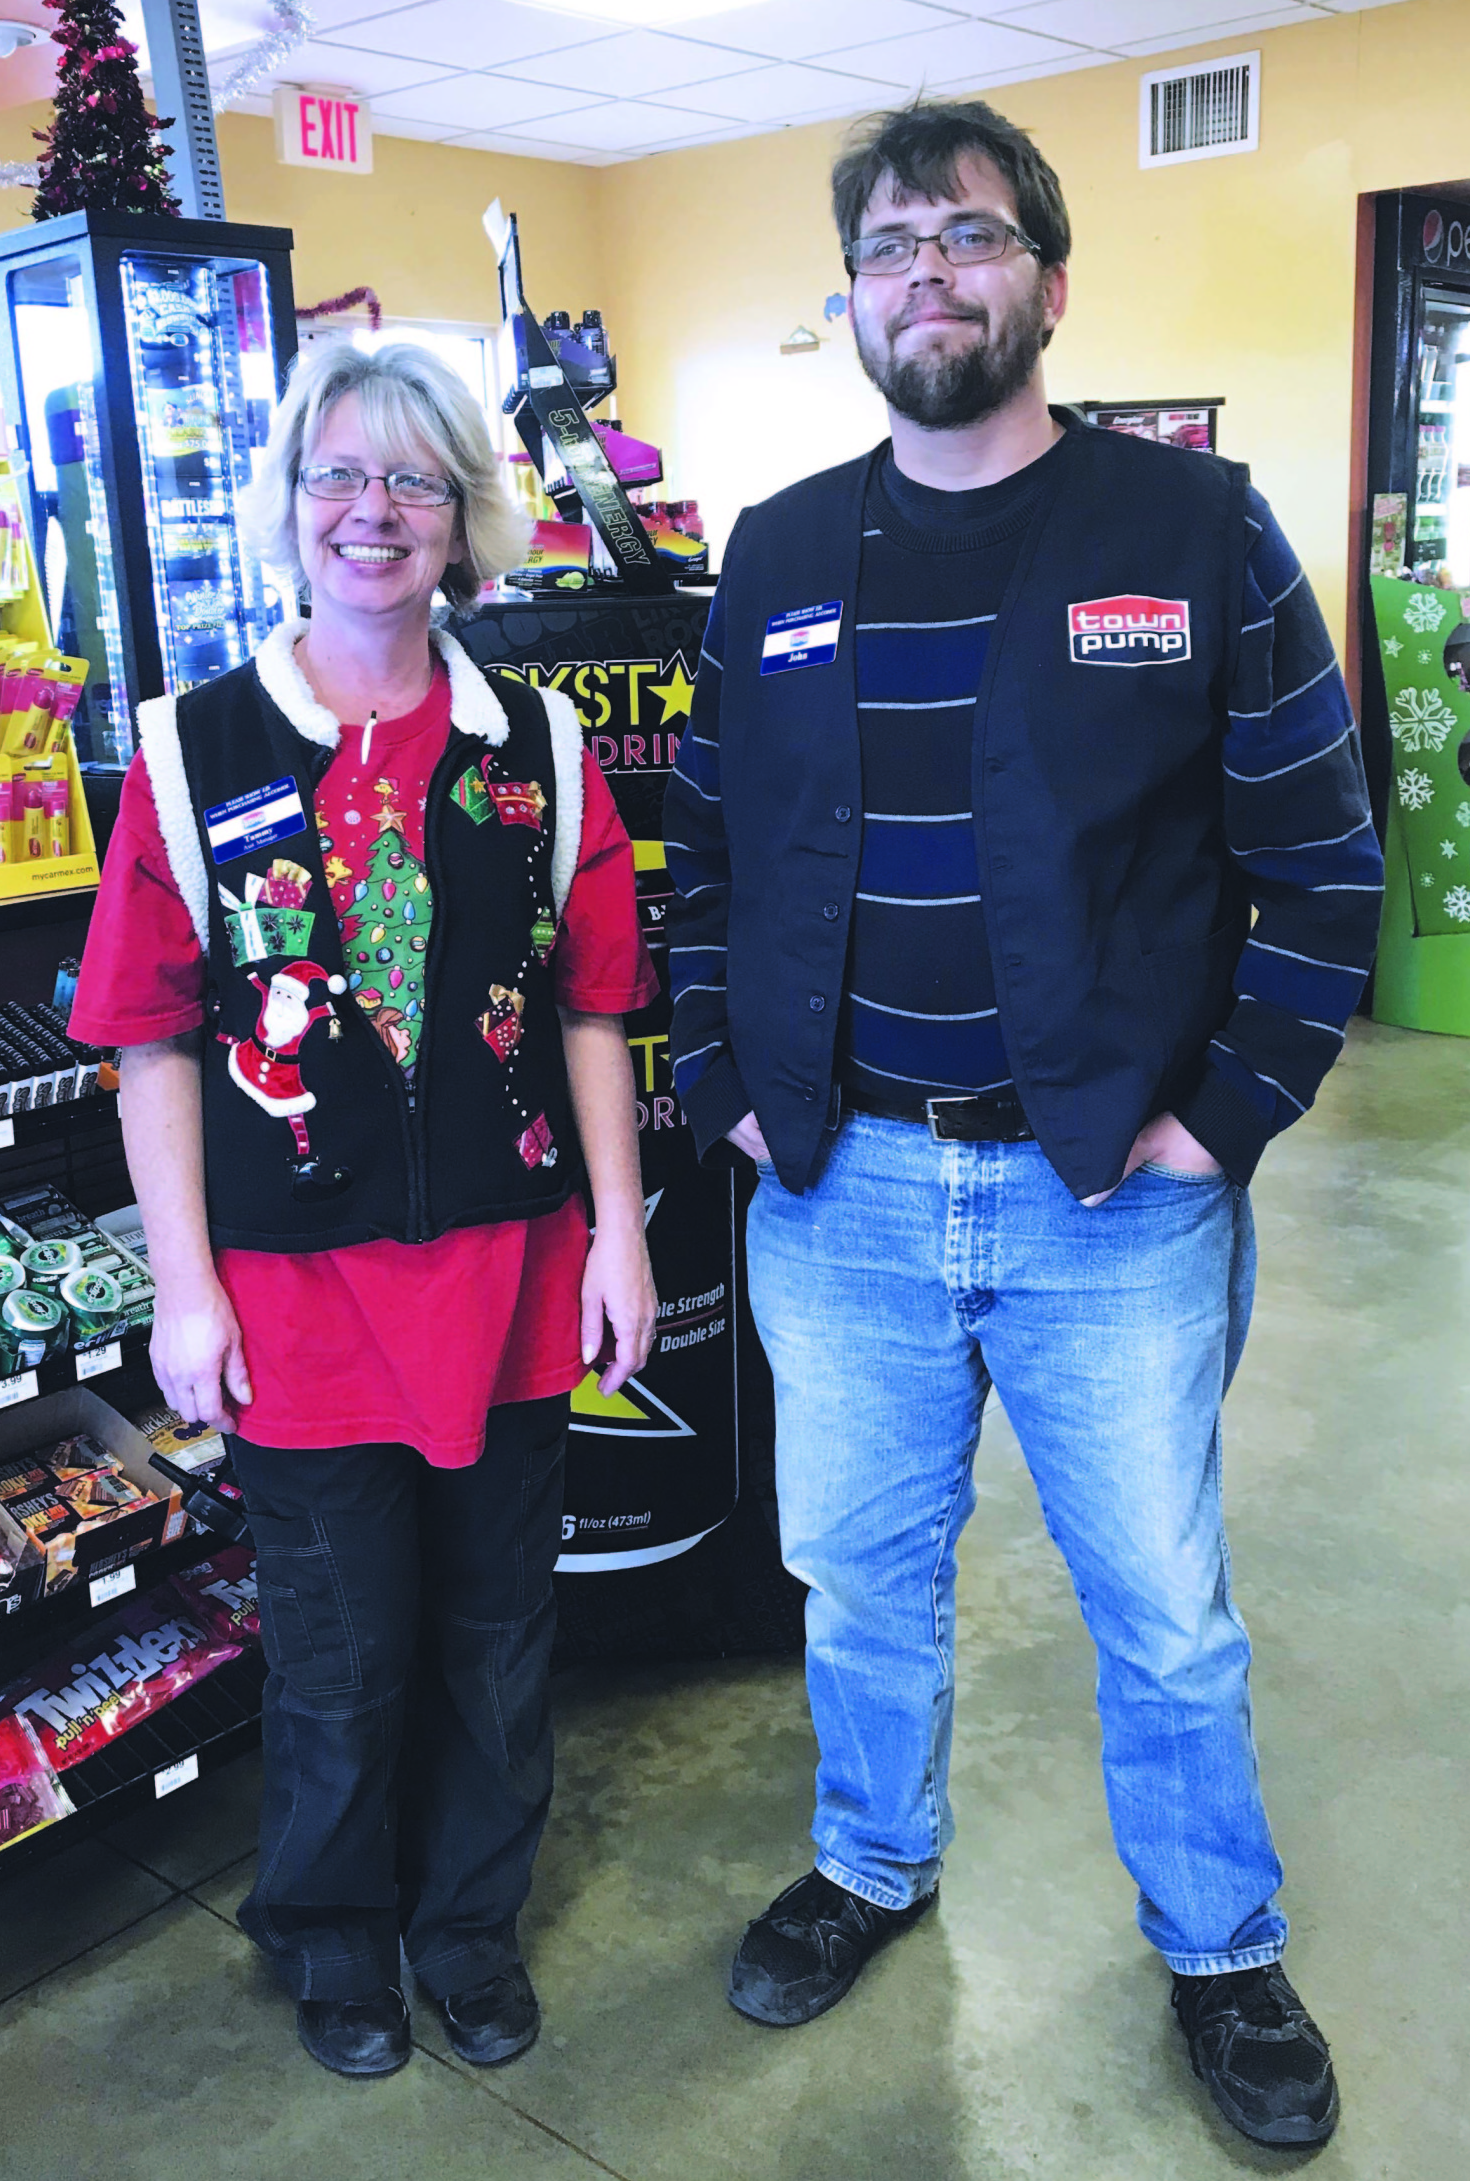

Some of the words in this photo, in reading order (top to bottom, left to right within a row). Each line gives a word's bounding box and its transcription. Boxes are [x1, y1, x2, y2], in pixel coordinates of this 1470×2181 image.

[299, 95, 359, 163] EXIT
[1076, 610, 1181, 630] town
[1081, 632, 1183, 655] pump
[787, 651, 808, 663] John
[244, 827, 273, 843] Tammy
[31, 865, 94, 881] mycarmex.com
[677, 1282, 725, 1315] Strength
[660, 1327, 706, 1353] Double
[708, 1317, 726, 1339] Size
[10, 1492, 59, 1520] RSHEY'S
[579, 1517, 606, 1530] fl/oz
[608, 1510, 652, 1530] (473ml)
[13, 1616, 209, 1735] Twizzlers
